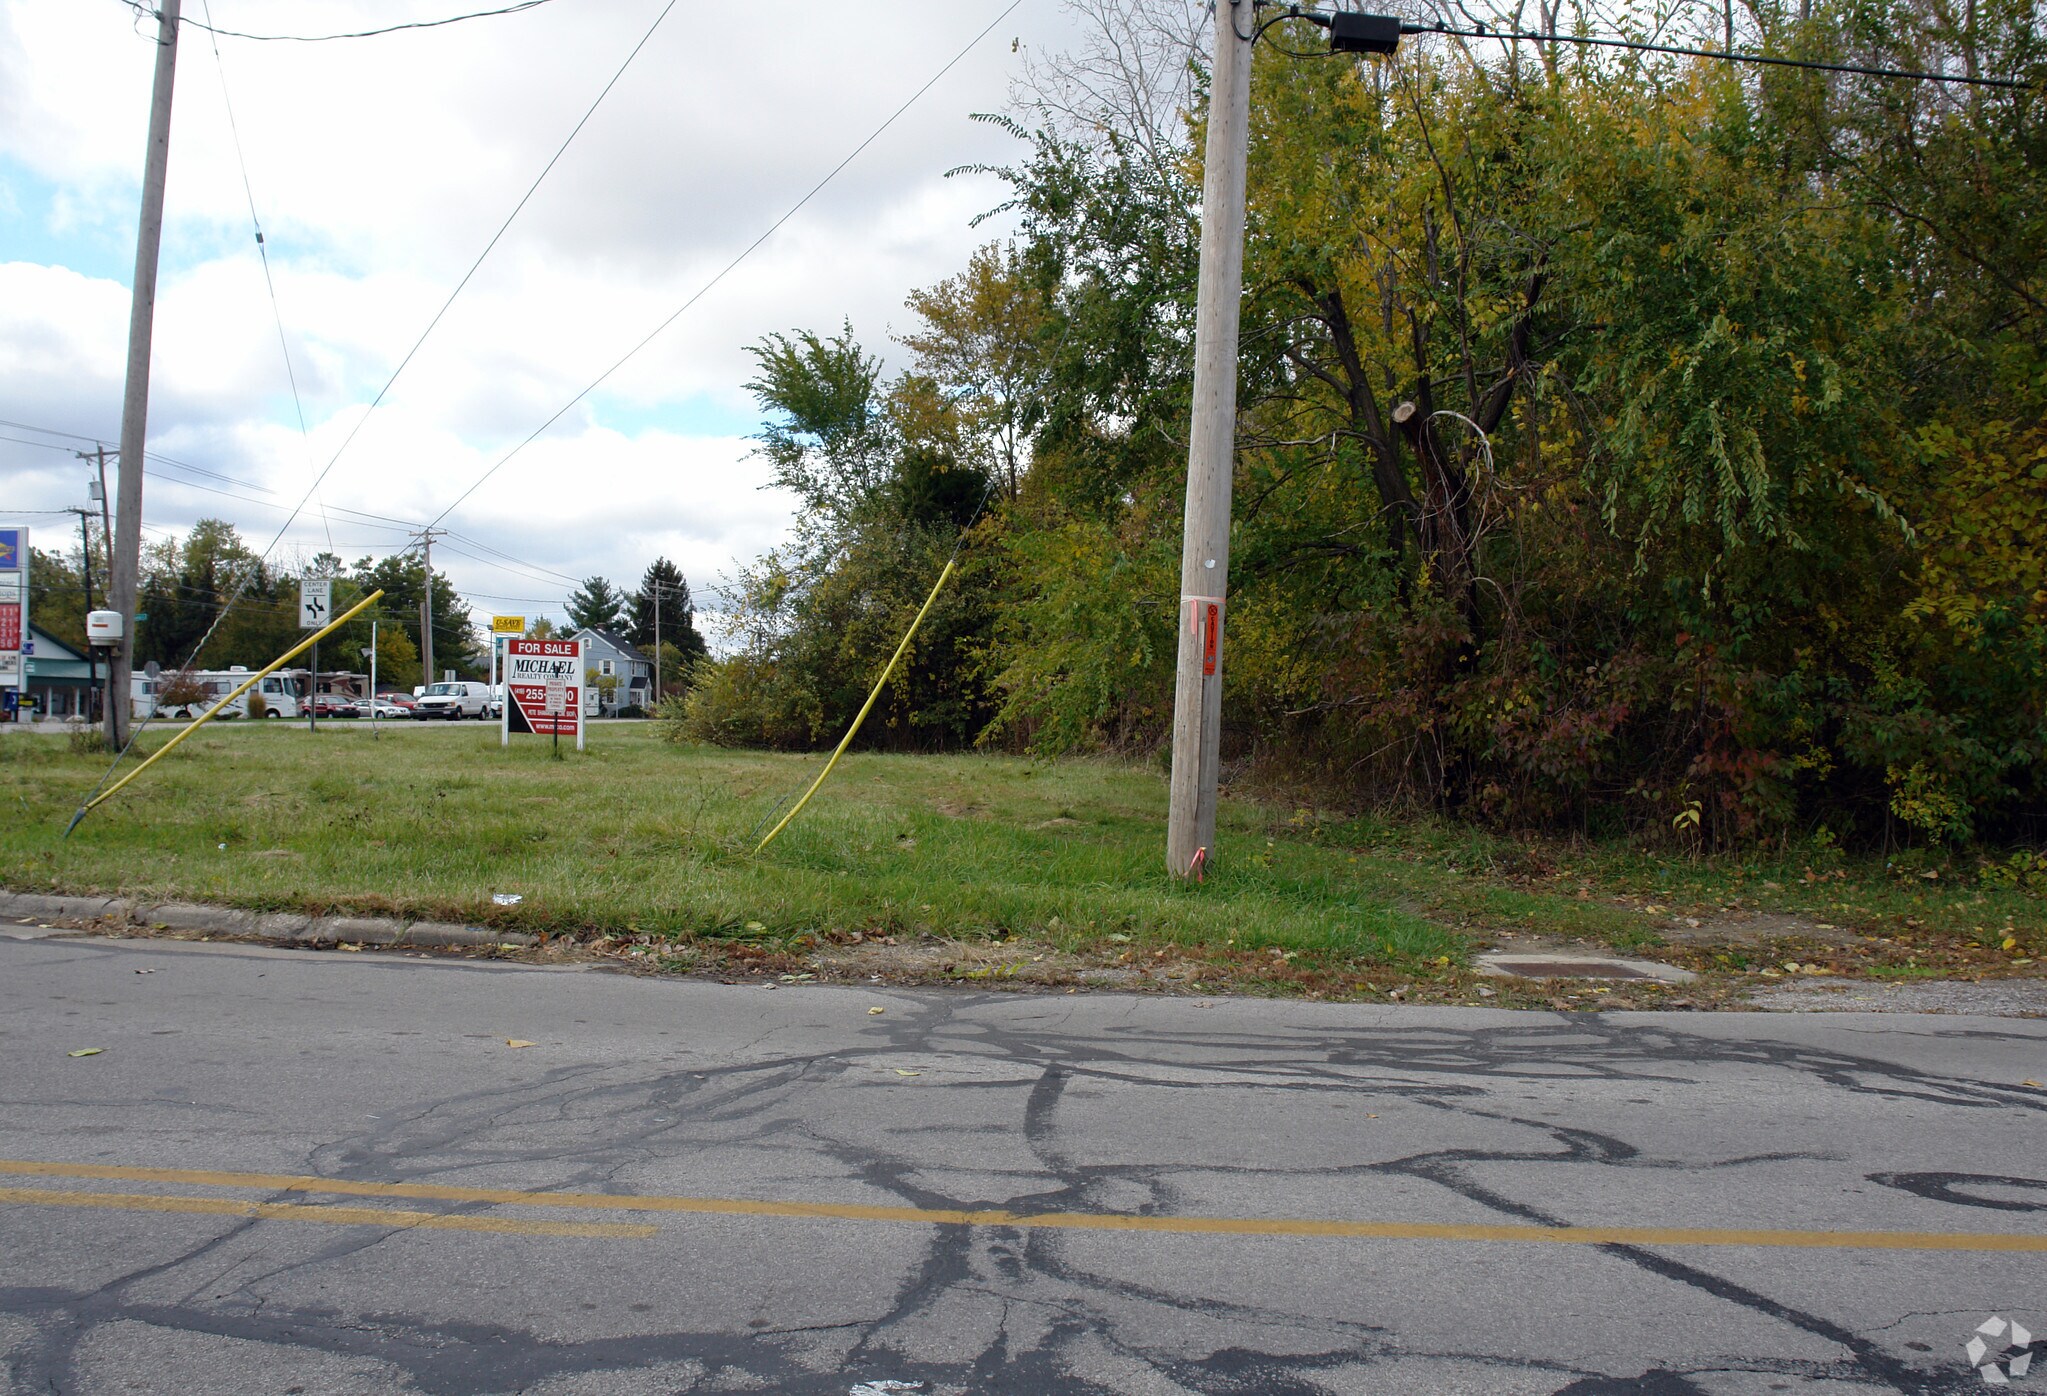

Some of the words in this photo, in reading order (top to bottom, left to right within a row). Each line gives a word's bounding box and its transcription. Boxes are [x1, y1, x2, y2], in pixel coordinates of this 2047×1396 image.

[518, 642, 540, 653] FOR
[544, 643, 572, 654] SALE
[512, 659, 575, 679] MICHAEL
[517, 672, 543, 680] REALTY
